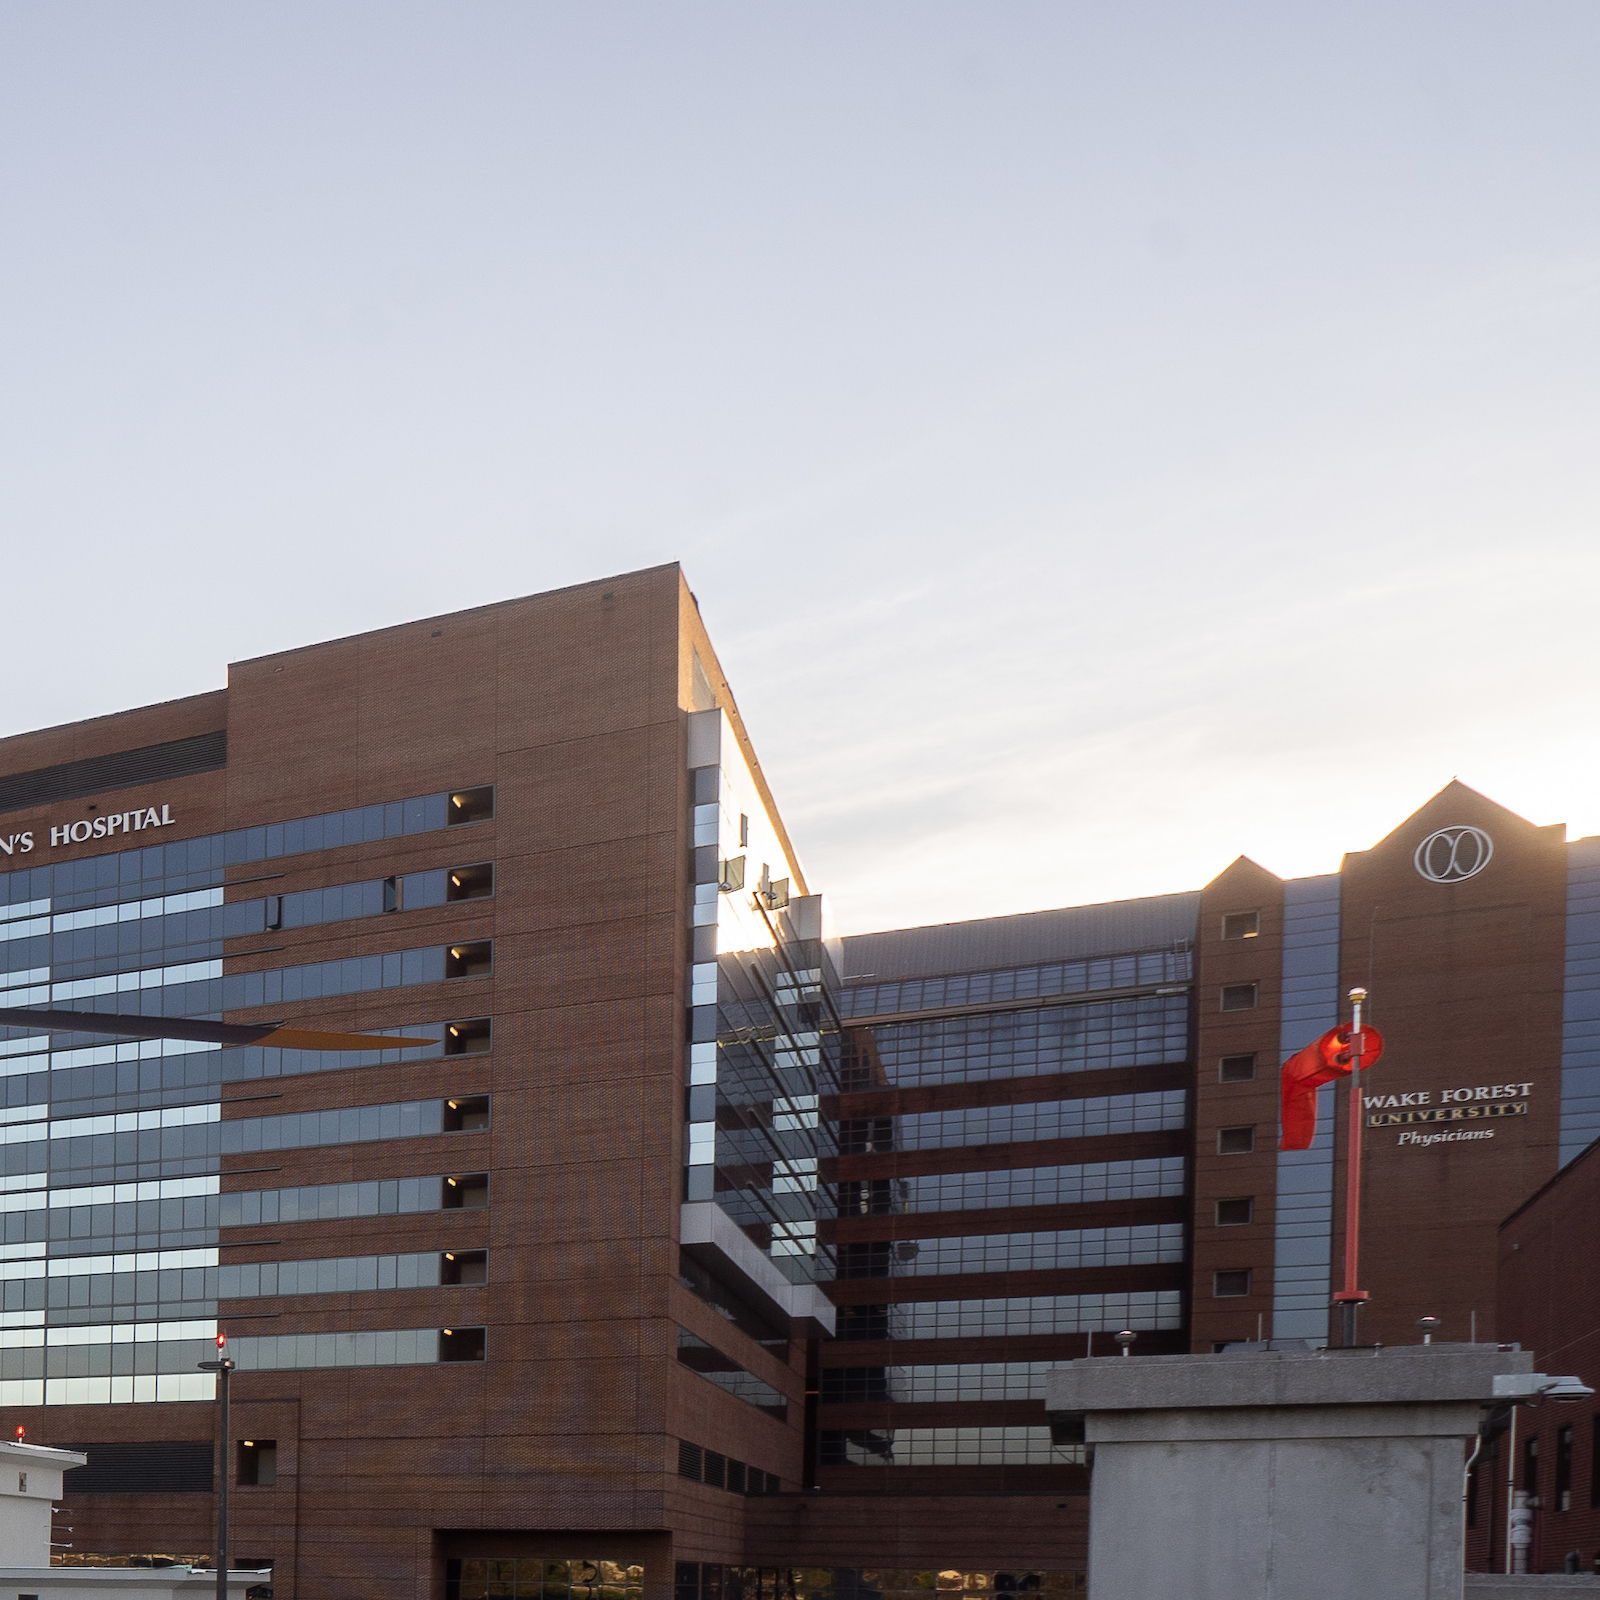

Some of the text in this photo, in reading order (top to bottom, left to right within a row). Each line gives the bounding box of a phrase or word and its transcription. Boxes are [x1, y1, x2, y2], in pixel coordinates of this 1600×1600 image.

[50, 804, 176, 847] HOSPITAL
[1363, 1082, 1534, 1109] WAKE FOREST
[1370, 1103, 1525, 1126] UNIVERSITY
[1397, 1128, 1494, 1147] Physicians
